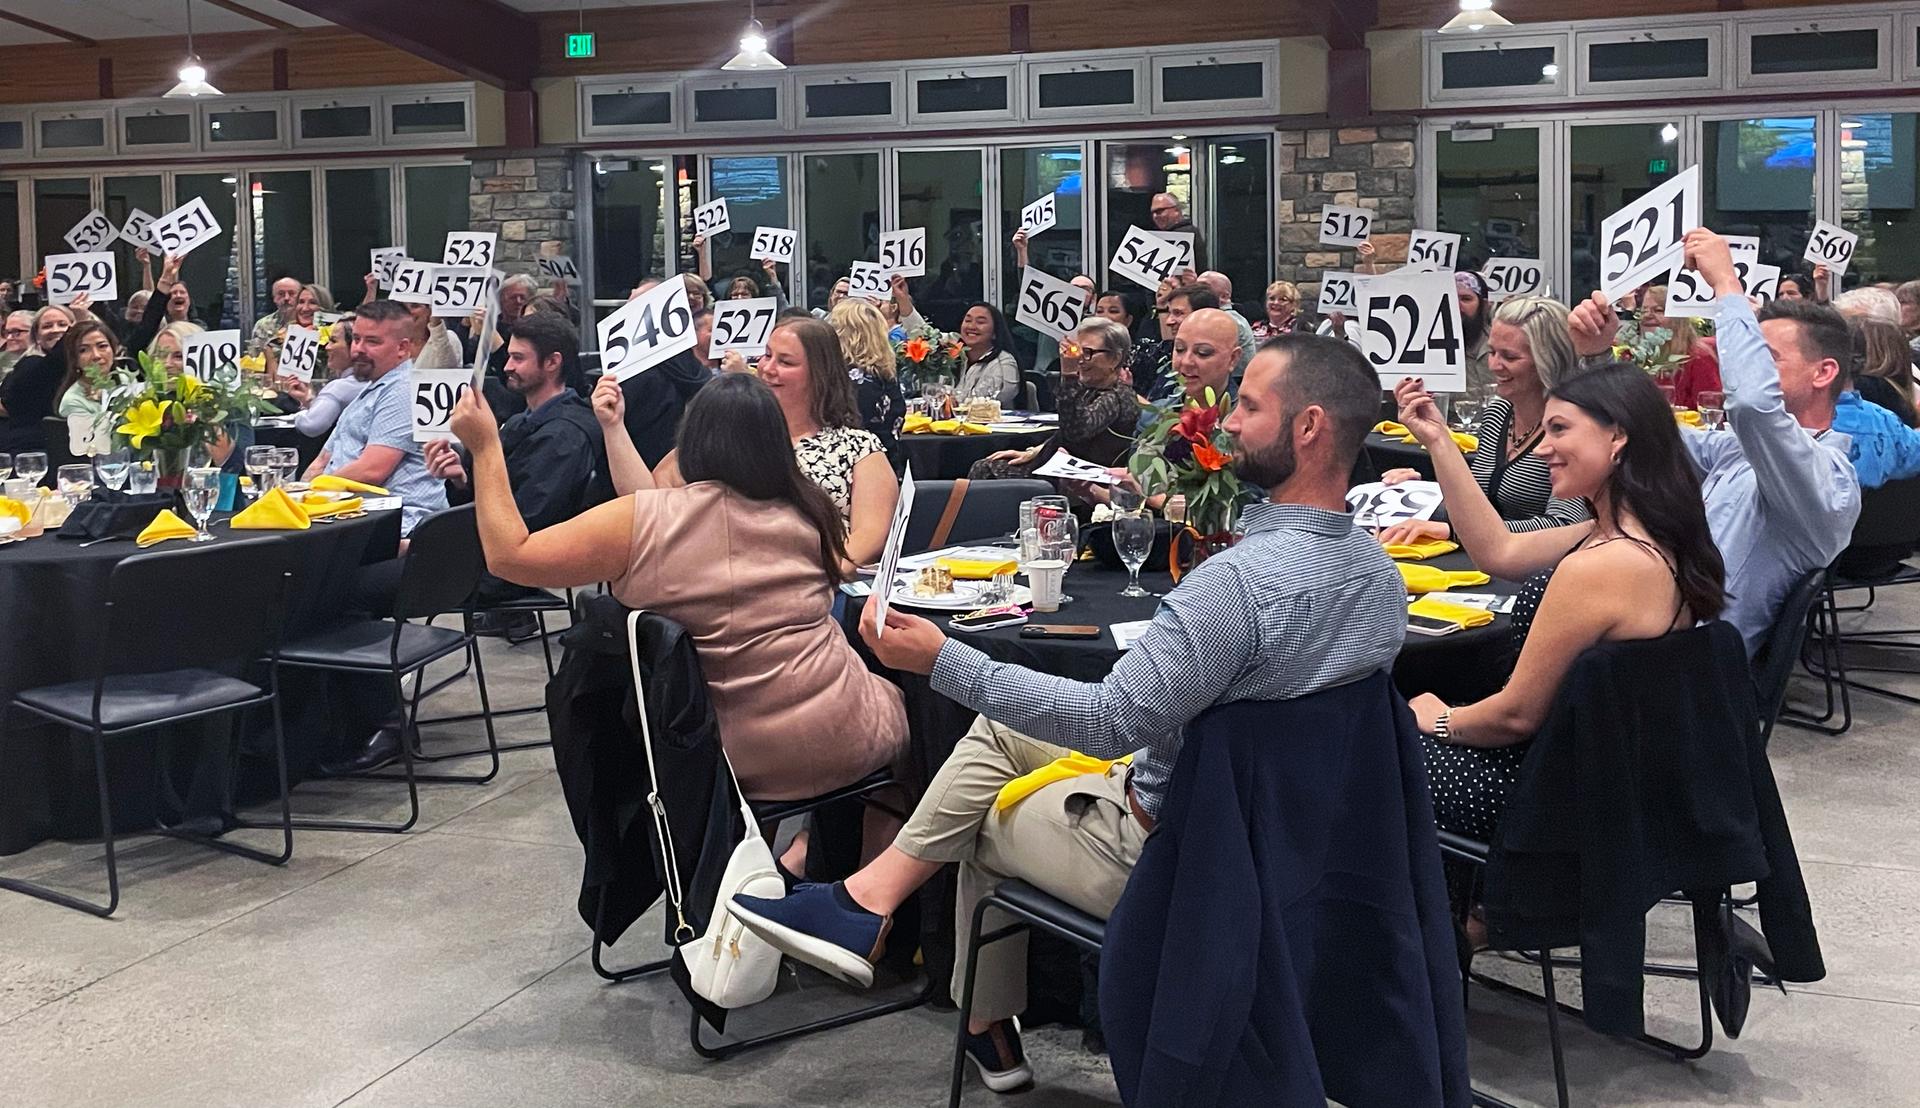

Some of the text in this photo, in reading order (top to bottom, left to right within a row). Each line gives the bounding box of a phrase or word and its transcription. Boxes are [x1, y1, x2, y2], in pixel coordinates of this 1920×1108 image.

[569, 35, 592, 56] EXIT
[160, 207, 212, 250] 551
[698, 204, 726, 232] 522
[1024, 200, 1054, 230] 505
[1324, 212, 1369, 240] 512
[73, 216, 110, 252] 539
[755, 233, 793, 256] 518
[1607, 189, 1684, 282] 521
[1810, 230, 1852, 263] 569
[447, 240, 491, 267] 523
[538, 258, 577, 279] 504
[883, 236, 923, 269] 516
[1118, 237, 1176, 282] 544
[51, 260, 113, 294] 529
[395, 269, 432, 295] 51
[434, 276, 485, 307] 557
[1322, 279, 1357, 307] 52
[1488, 265, 1541, 294] 509
[1022, 279, 1084, 332] 565
[605, 288, 690, 369] 546
[715, 309, 775, 346] 527
[1366, 293, 1460, 365] 524
[186, 342, 238, 383] 508
[282, 335, 318, 371] 545
